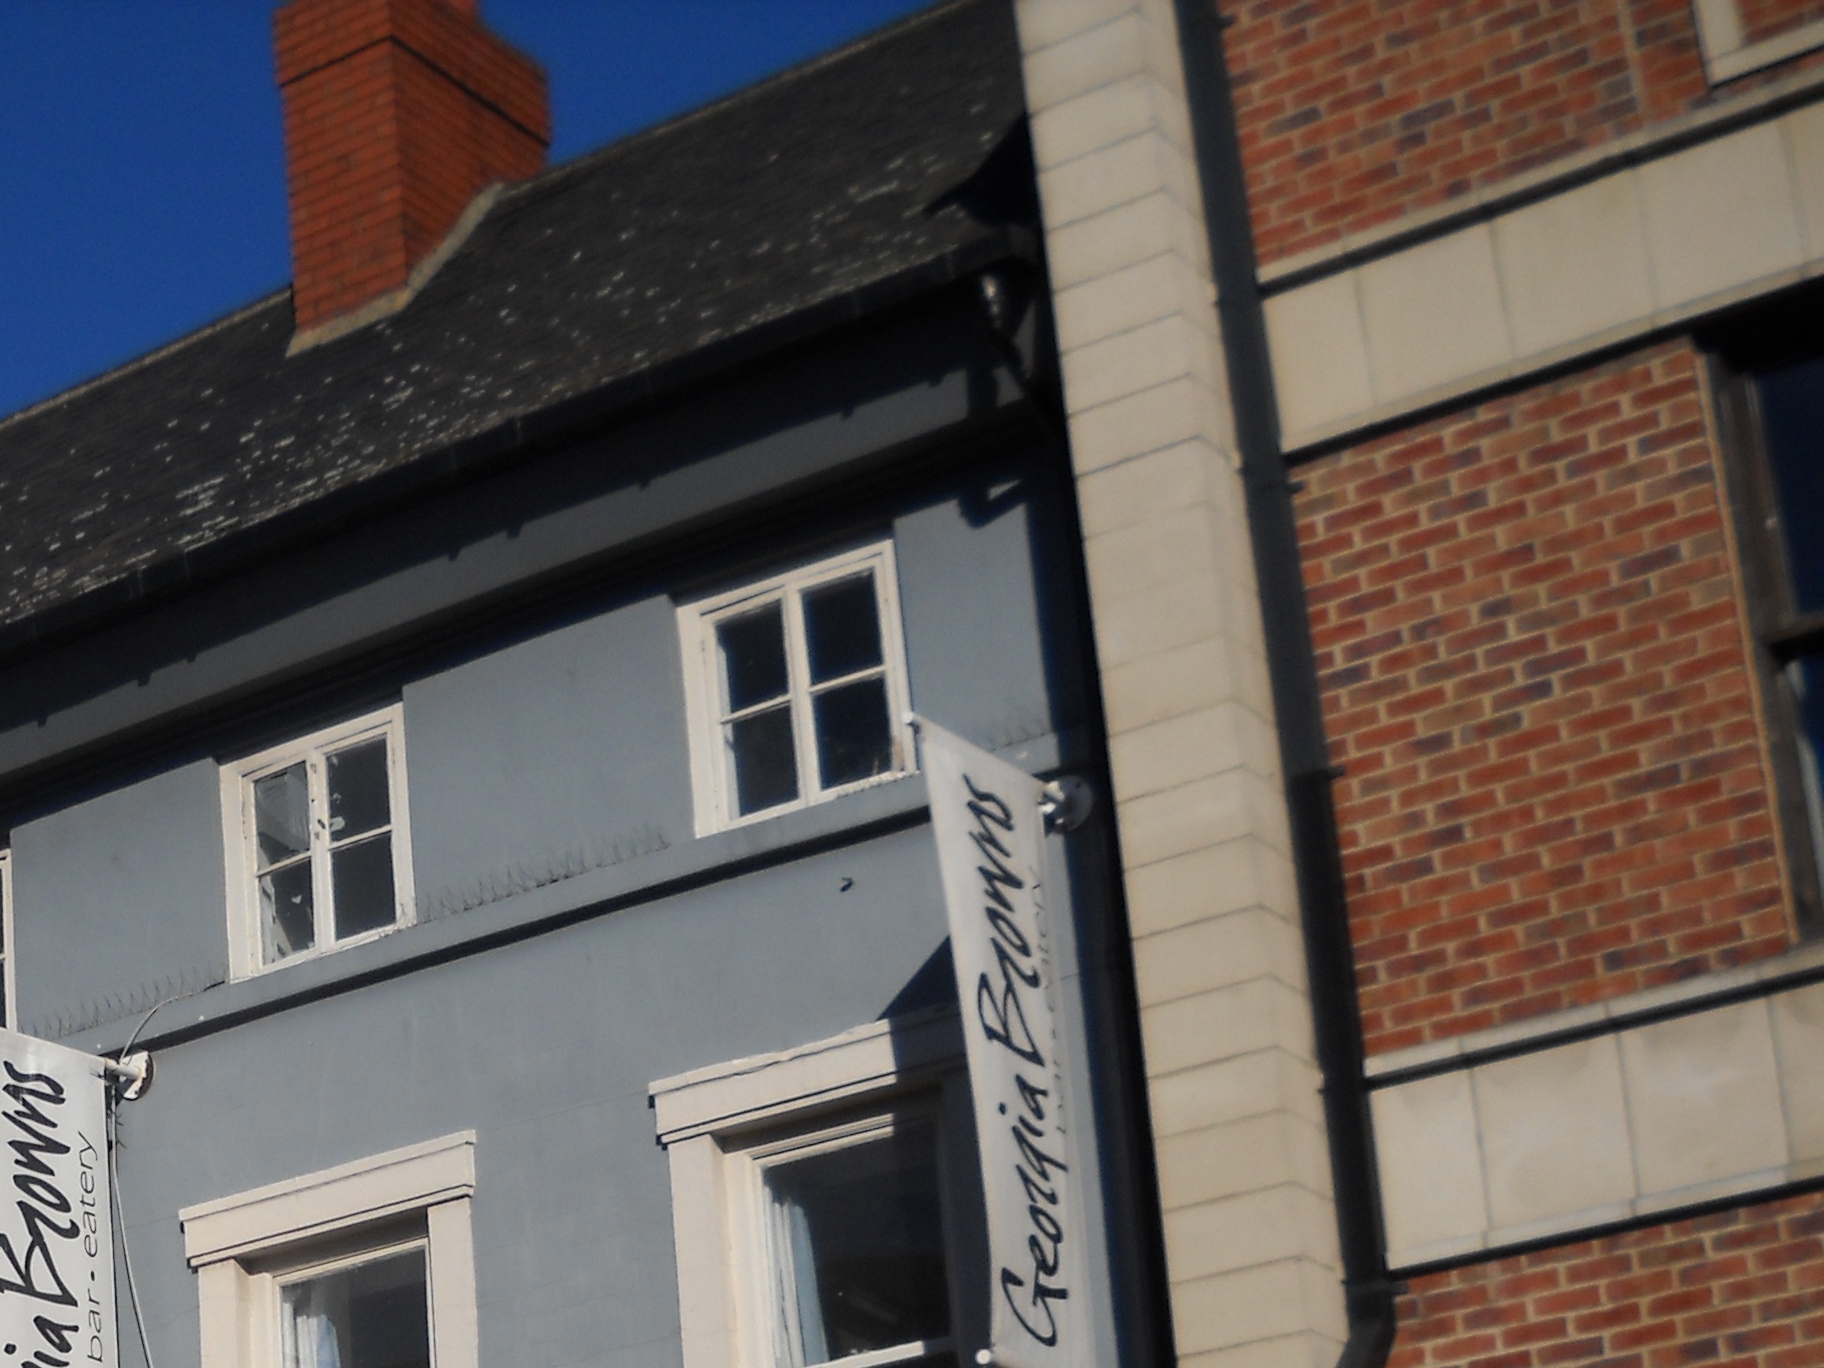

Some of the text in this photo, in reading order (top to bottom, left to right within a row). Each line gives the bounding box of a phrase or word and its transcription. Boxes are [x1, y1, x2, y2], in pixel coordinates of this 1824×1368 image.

[77, 1130, 104, 1363] bar eatery
[1002, 1070, 1068, 1348] Georgia
